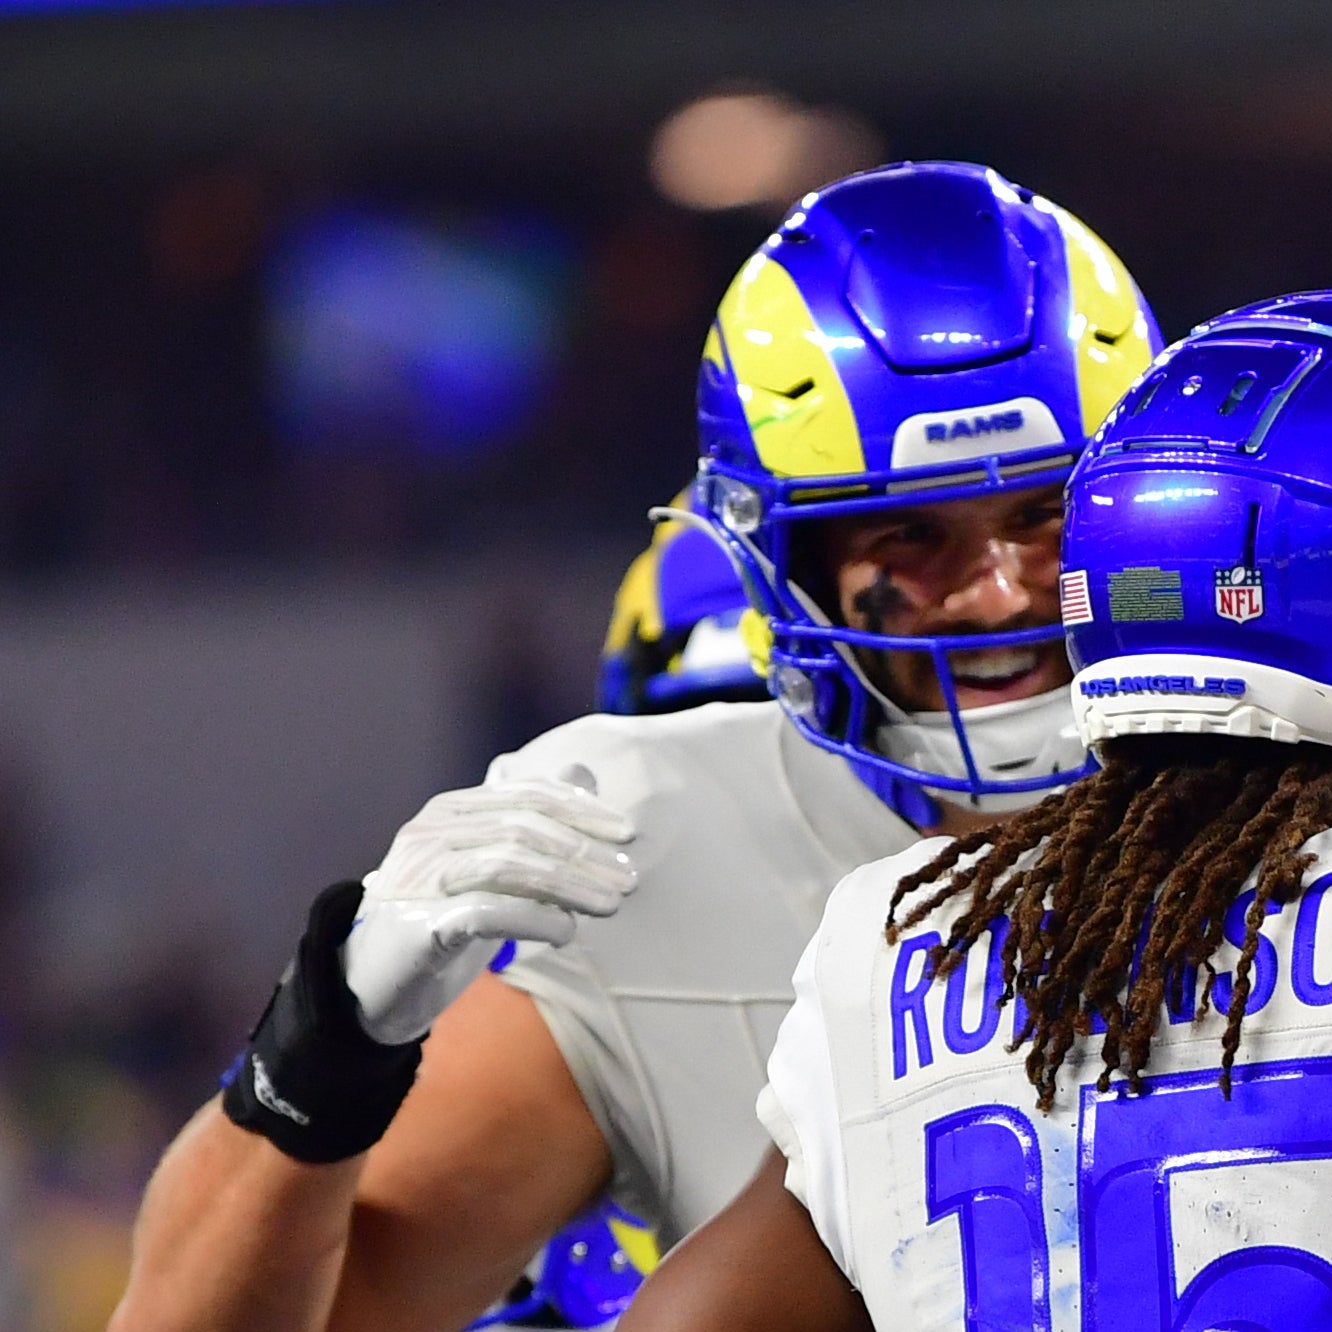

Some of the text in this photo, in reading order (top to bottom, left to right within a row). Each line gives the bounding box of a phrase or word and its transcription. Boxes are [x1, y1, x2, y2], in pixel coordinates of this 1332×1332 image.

[925, 409, 1024, 442] RAMS
[1219, 588, 1260, 618] NFL
[1080, 674, 1247, 697] LOS ANGELES
